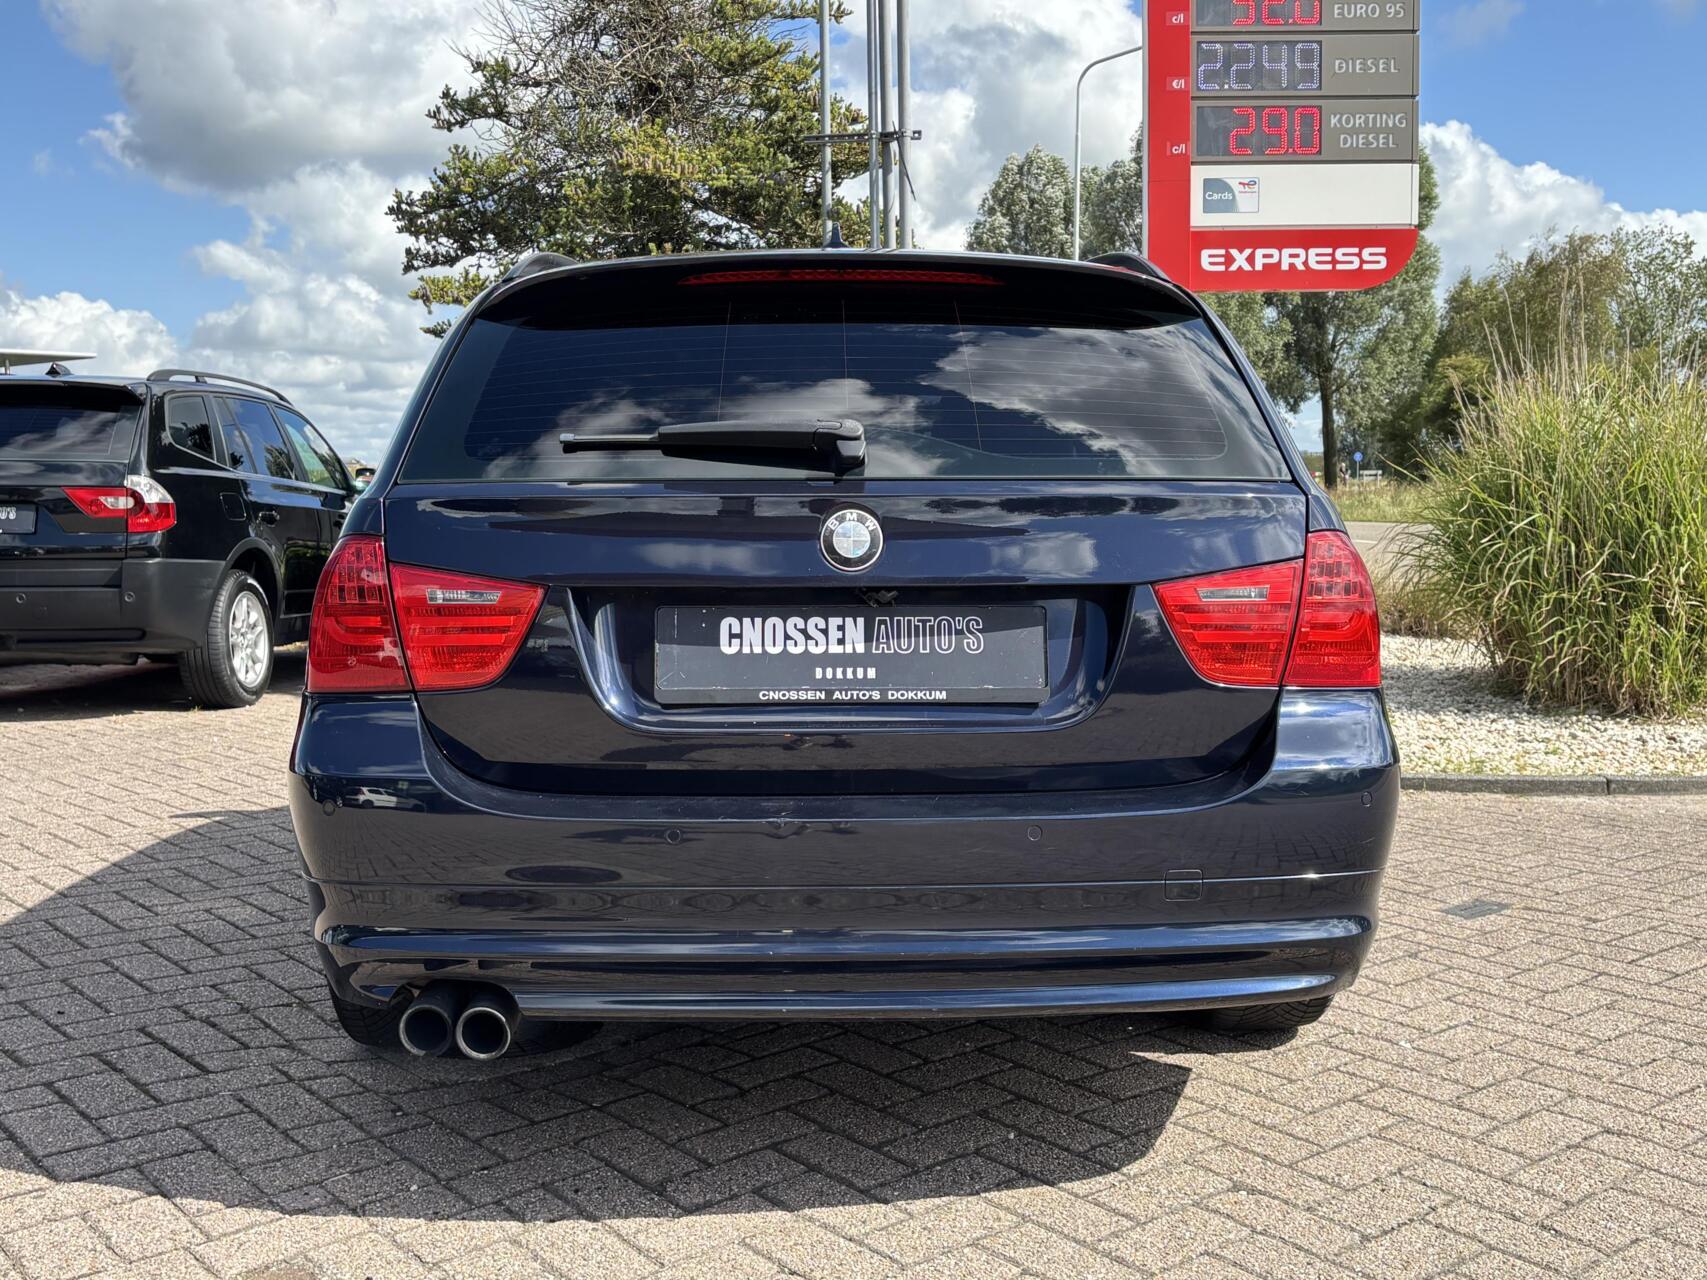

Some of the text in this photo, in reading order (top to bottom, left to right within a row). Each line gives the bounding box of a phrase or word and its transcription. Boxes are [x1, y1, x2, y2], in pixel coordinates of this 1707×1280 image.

[1334, 3, 1405, 19] EURO 95
[1335, 59, 1399, 74] DIESEL
[1331, 113, 1407, 129] KORTING
[1230, 107, 1321, 155] 29.0
[1340, 134, 1398, 149] DIESEL
[1205, 191, 1233, 200] Cards
[1200, 247, 1388, 272] EXPRESS
[827, 512, 877, 531] BMW
[719, 616, 985, 655] CNOSSEN AUTO'S
[814, 667, 877, 680] DOKKUM
[758, 689, 947, 701] CNOSSEN AUTO'S DOKKUM
